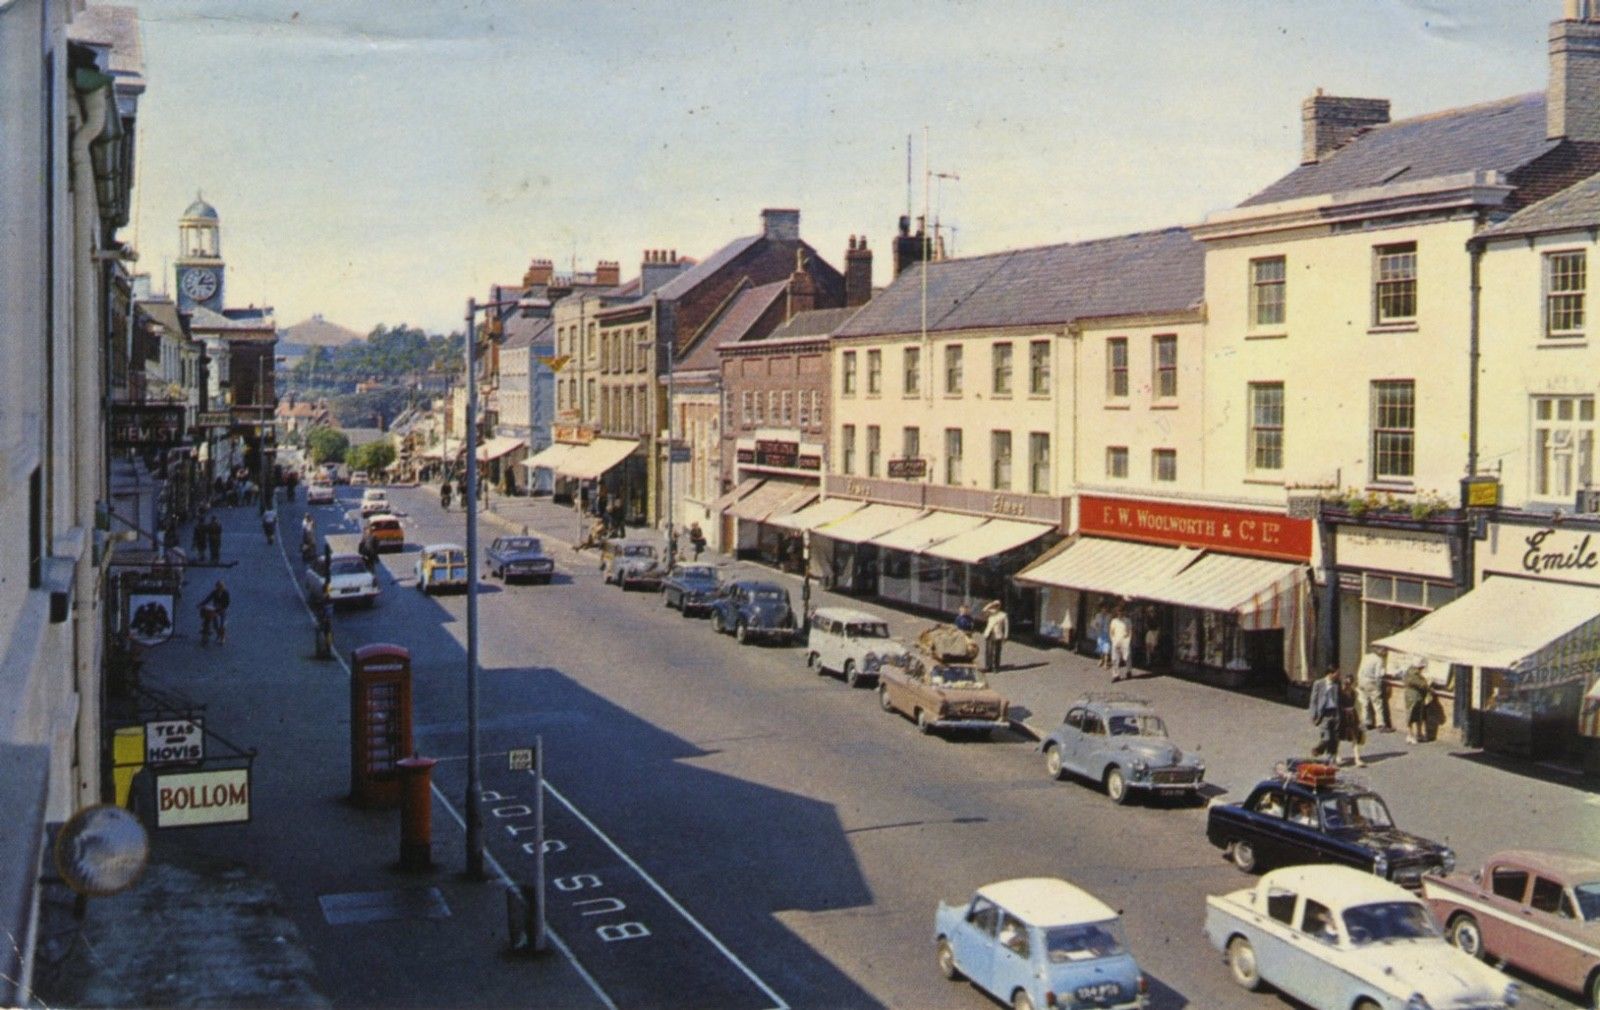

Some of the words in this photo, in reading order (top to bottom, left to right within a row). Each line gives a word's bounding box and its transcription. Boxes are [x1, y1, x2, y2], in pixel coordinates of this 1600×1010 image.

[1118, 508, 1132, 528] W.
[1222, 524, 1232, 538] &
[1523, 530, 1599, 573] Emile
[155, 725, 194, 736] TEAS
[150, 746, 200, 760] HOVIS
[160, 784, 247, 812] BOLLOM
[481, 789, 568, 855] STOP
[554, 873, 651, 942] BUS
